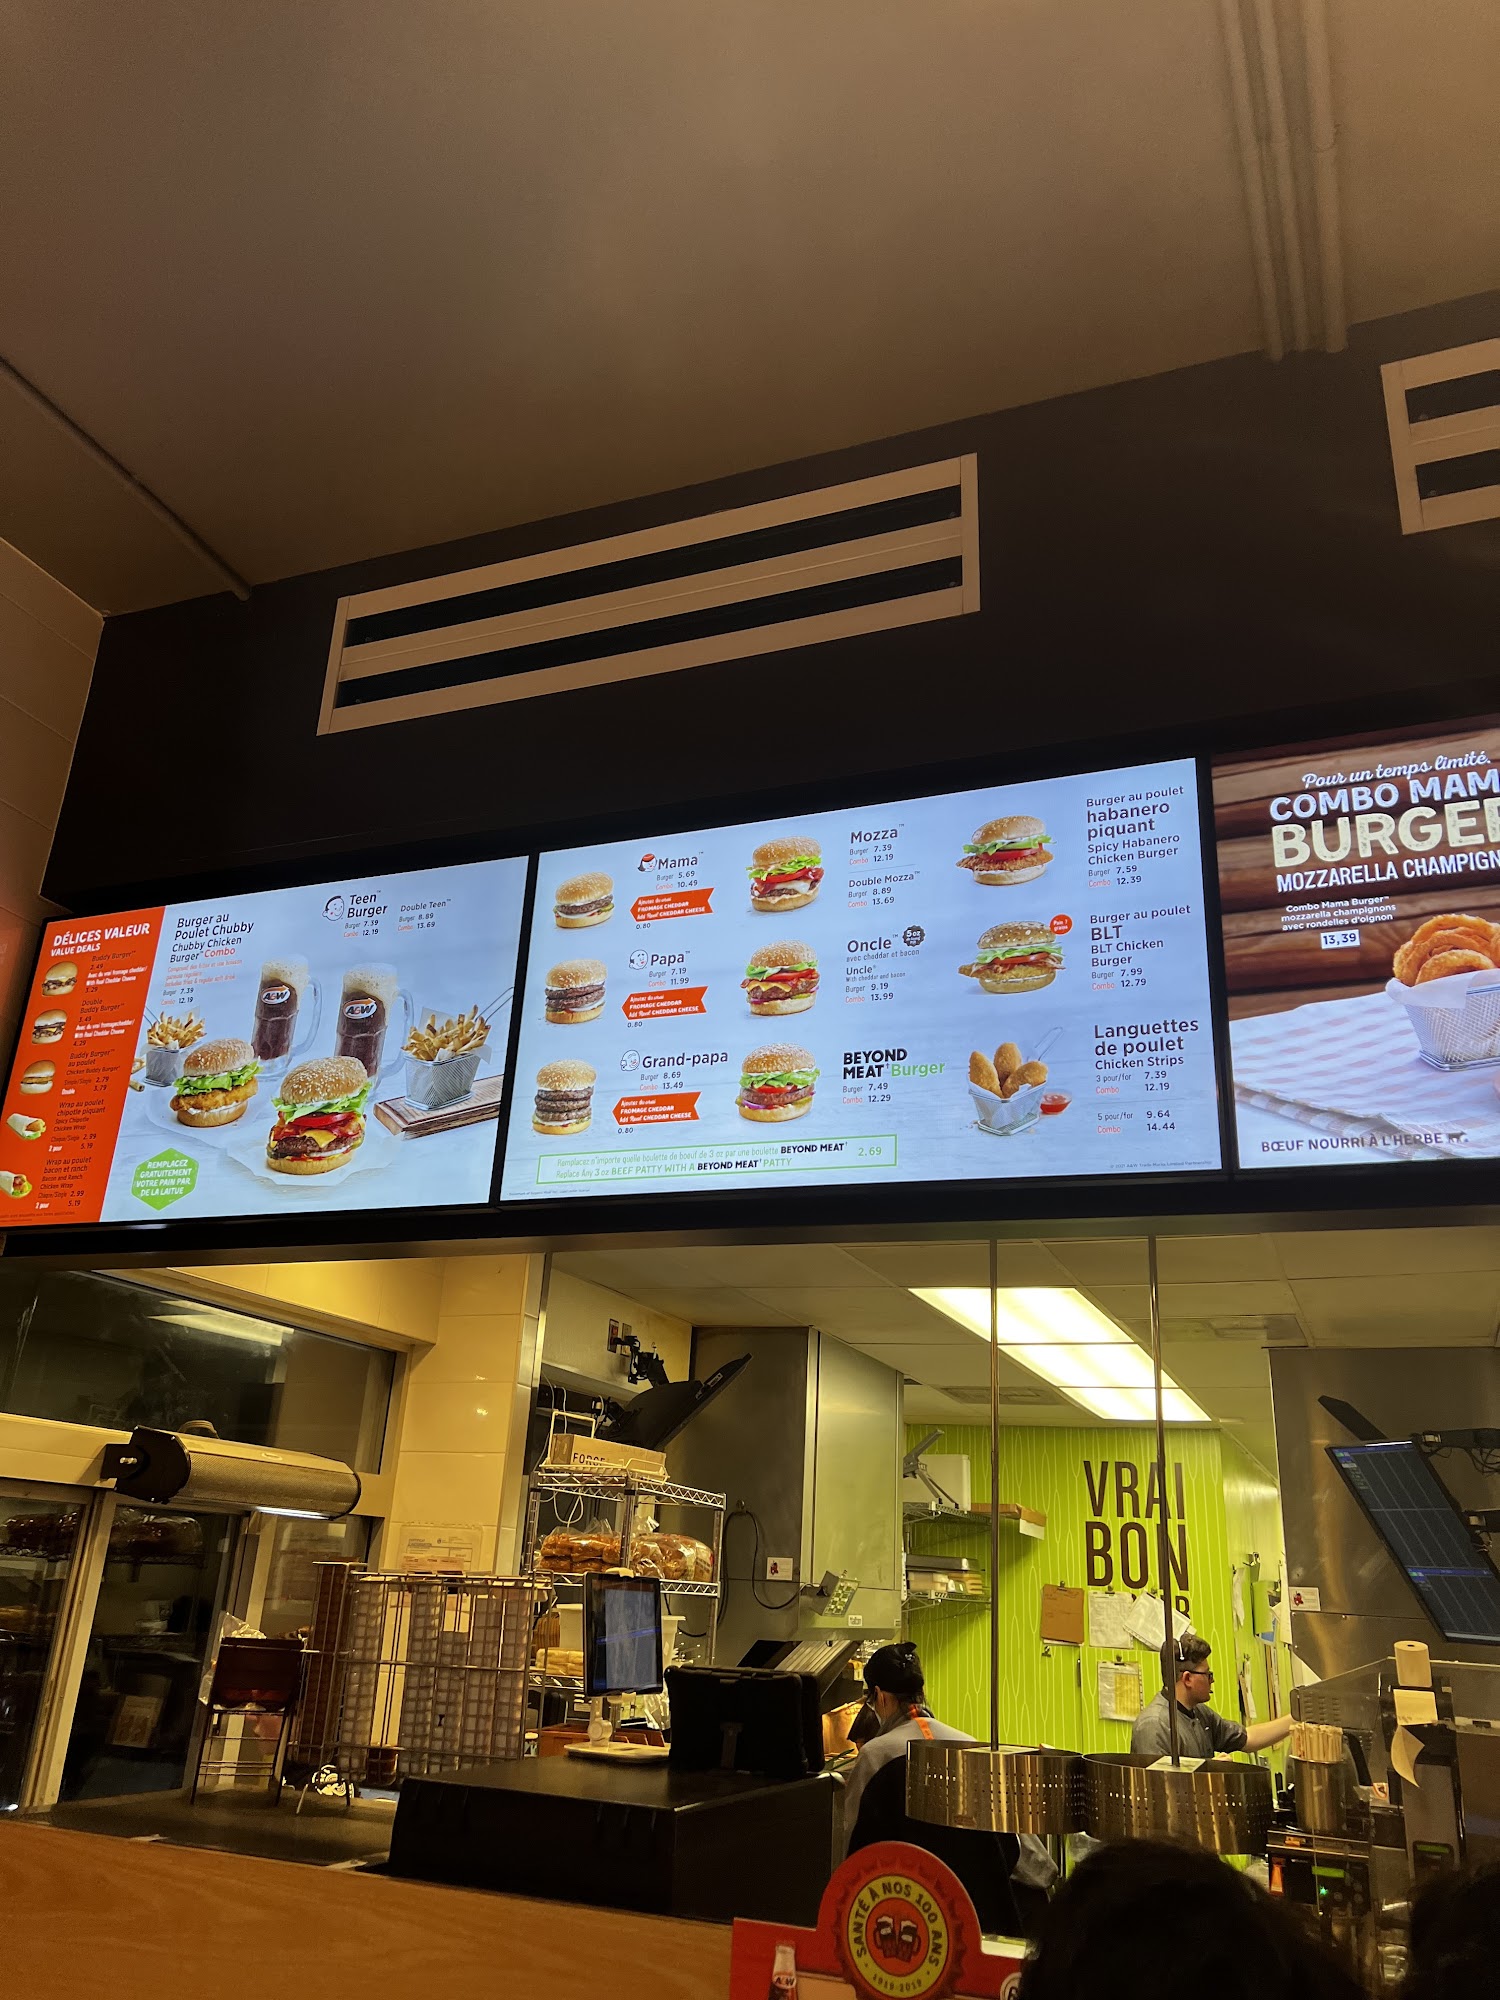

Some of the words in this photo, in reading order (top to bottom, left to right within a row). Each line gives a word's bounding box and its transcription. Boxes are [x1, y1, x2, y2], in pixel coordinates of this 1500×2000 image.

[1302, 772, 1347, 789] Pour
[1349, 768, 1374, 783] un
[1375, 761, 1432, 780] temps
[1435, 750, 1491, 771] limité.
[1086, 794, 1125, 807] Burger
[1128, 793, 1142, 802] au
[1145, 785, 1184, 800] poulet
[1270, 783, 1399, 821] COMBO
[1087, 802, 1170, 823] habanero
[1087, 818, 1155, 841] piquant
[849, 847, 869, 856] Burger
[873, 844, 892, 853] 7.39
[1087, 841, 1119, 854] Spicy
[1122, 834, 1180, 849] Habanero
[873, 853, 894, 862] 12.19
[1088, 852, 1134, 865] Chicken
[1138, 847, 1179, 860] Burger
[1088, 868, 1110, 877] Burger
[1116, 865, 1138, 874] 7.59
[1276, 861, 1398, 894] MOZZARELLA
[848, 876, 882, 888] Double
[1088, 879, 1111, 888] Combo
[1116, 875, 1142, 885] 12.39
[848, 890, 867, 899] Burger
[872, 886, 892, 896] 8.89
[400, 902, 427, 912] Double
[872, 896, 895, 906] 13.69
[1286, 903, 1320, 913] Combo
[1322, 900, 1349, 909] Mama
[347, 905, 388, 918] Burger
[1090, 912, 1131, 924] Burger
[1133, 910, 1148, 920] au
[1151, 905, 1191, 919] poulet
[1281, 910, 1331, 922] mozzarella
[1333, 904, 1397, 917] champignons
[177, 915, 214, 929] Burger
[215, 913, 230, 923] au
[1282, 923, 1305, 931] avec
[1306, 918, 1349, 929] rondelles
[1351, 913, 1393, 924] d'oignon
[53, 929, 101, 947] DÉLICES
[104, 922, 150, 940] VALEUR
[174, 927, 210, 941] Poulet
[212, 921, 255, 936] Chubby
[1091, 925, 1123, 941] BLT
[172, 941, 205, 953] Chubby
[207, 937, 242, 948] Chicken
[1323, 932, 1357, 945] 13,39
[50, 946, 75, 957] VALUE
[76, 943, 101, 954] DEALS
[204, 947, 236, 958] Combo
[1091, 944, 1113, 954] BLT
[1116, 939, 1164, 952] Chicken
[1091, 955, 1132, 967] Burger
[1091, 970, 1115, 980] Burger
[1120, 968, 1143, 977] 7.99
[845, 985, 866, 994] Burger
[870, 982, 889, 991] 9.19
[1091, 982, 1116, 991] Combo
[1120, 978, 1147, 988] 12.79
[1094, 1018, 1199, 1039] Languettes
[1094, 1041, 1117, 1056] de
[1123, 1036, 1184, 1057] poulet
[642, 1051, 728, 1069] Grand-papa
[843, 1047, 908, 1065] BEYOND
[1095, 1057, 1144, 1070] Chicken
[1147, 1055, 1184, 1068] Strips
[76, 1059, 96, 1067] poulet
[891, 1062, 945, 1077] Burger
[640, 1073, 659, 1081] Burger
[663, 1071, 681, 1080] 8.69
[1096, 1074, 1101, 1083] 3
[1103, 1073, 1132, 1083] pour/for
[1144, 1071, 1167, 1080] 7.39
[842, 1085, 864, 1094] Burger
[868, 1082, 889, 1091] 7.49
[1096, 1086, 1120, 1094] Combo
[1145, 1082, 1170, 1091] 12.19
[59, 1101, 75, 1109] Wrap
[85, 1099, 104, 1108] poulet
[868, 1094, 891, 1103] 12.29
[57, 1108, 81, 1117] chipotle
[82, 1107, 106, 1116] piquant
[1097, 1113, 1103, 1121] 5
[1105, 1111, 1134, 1122] pour/for
[1146, 1109, 1171, 1119] 9.64
[1097, 1125, 1121, 1134] Combo
[1146, 1122, 1176, 1131] 14.44
[1261, 1139, 1304, 1153] BŒUF
[1308, 1137, 1365, 1150] NOURRI
[1369, 1133, 1378, 1147] À
[1382, 1132, 1443, 1147] L'HERBE
[857, 1146, 882, 1157] 2.69
[71, 1156, 91, 1165] poulet
[147, 1159, 189, 1169] REMPLACEZ
[44, 1166, 62, 1174] bacon
[71, 1164, 88, 1172] ranch
[140, 1168, 192, 1178] GRATUITEMENT
[556, 1170, 580, 1179] Replace
[594, 1168, 600, 1176] 3
[611, 1167, 633, 1175] BEEF
[635, 1165, 662, 1174] PATTY
[664, 1163, 688, 1172] WITH
[688, 1163, 695, 1171] A
[697, 1160, 733, 1171] BEYOND
[763, 1157, 793, 1167] PATTY
[136, 1179, 159, 1188] VOTRE
[159, 1178, 175, 1186] PAIN
[176, 1177, 191, 1185] PAR
[140, 1188, 150, 1197] DE
[150, 1187, 159, 1196] LA
[160, 1186, 185, 1195] LAITUE
[1083, 1460, 1185, 1520] VRAI
[1085, 1520, 1190, 1592] BON
[853, 1898, 870, 1958] SANTÉ
[882, 1881, 912, 1897] NOS
[916, 1893, 938, 1923] 100
[929, 1929, 943, 1967] ANS
